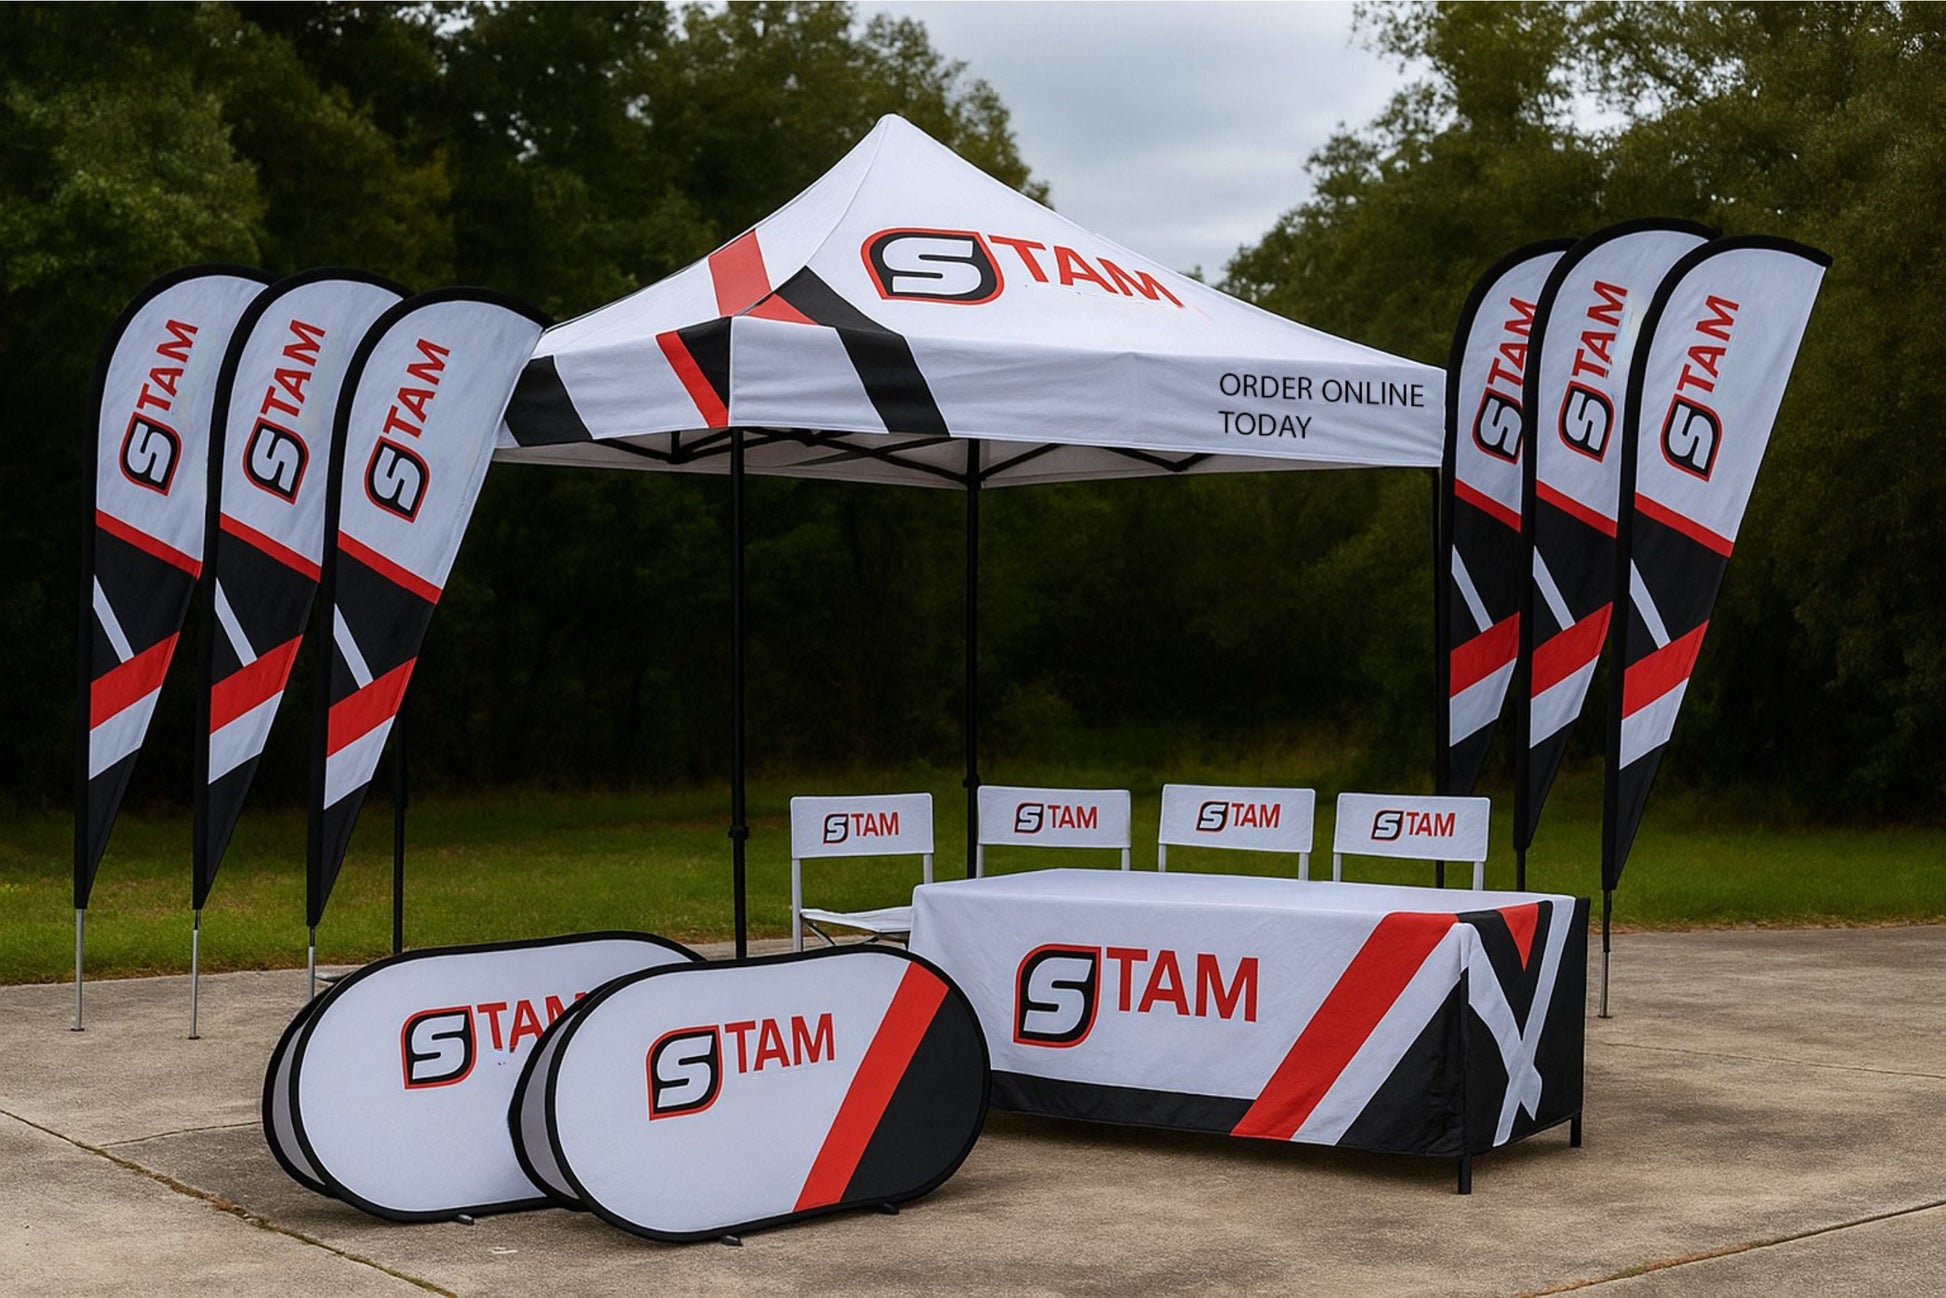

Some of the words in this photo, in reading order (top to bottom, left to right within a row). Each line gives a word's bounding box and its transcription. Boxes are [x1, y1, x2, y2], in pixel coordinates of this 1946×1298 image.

[860, 227, 1185, 306] STAM
[119, 319, 198, 496] STAM
[242, 319, 325, 504] STAM
[1219, 373, 1312, 400] ORDER
[1321, 380, 1424, 407] ONLINE
[1558, 280, 1628, 463] STAM
[1660, 295, 1740, 482] STAM
[363, 338, 450, 524] STAM
[1219, 411, 1312, 438] TODAY
[823, 811, 900, 844] STAM
[1014, 802, 1099, 833] STAM
[1196, 800, 1281, 832] STAM
[1371, 810, 1456, 842] STAM
[1013, 943, 1259, 1048] STAM
[646, 1013, 836, 1121] STAM
